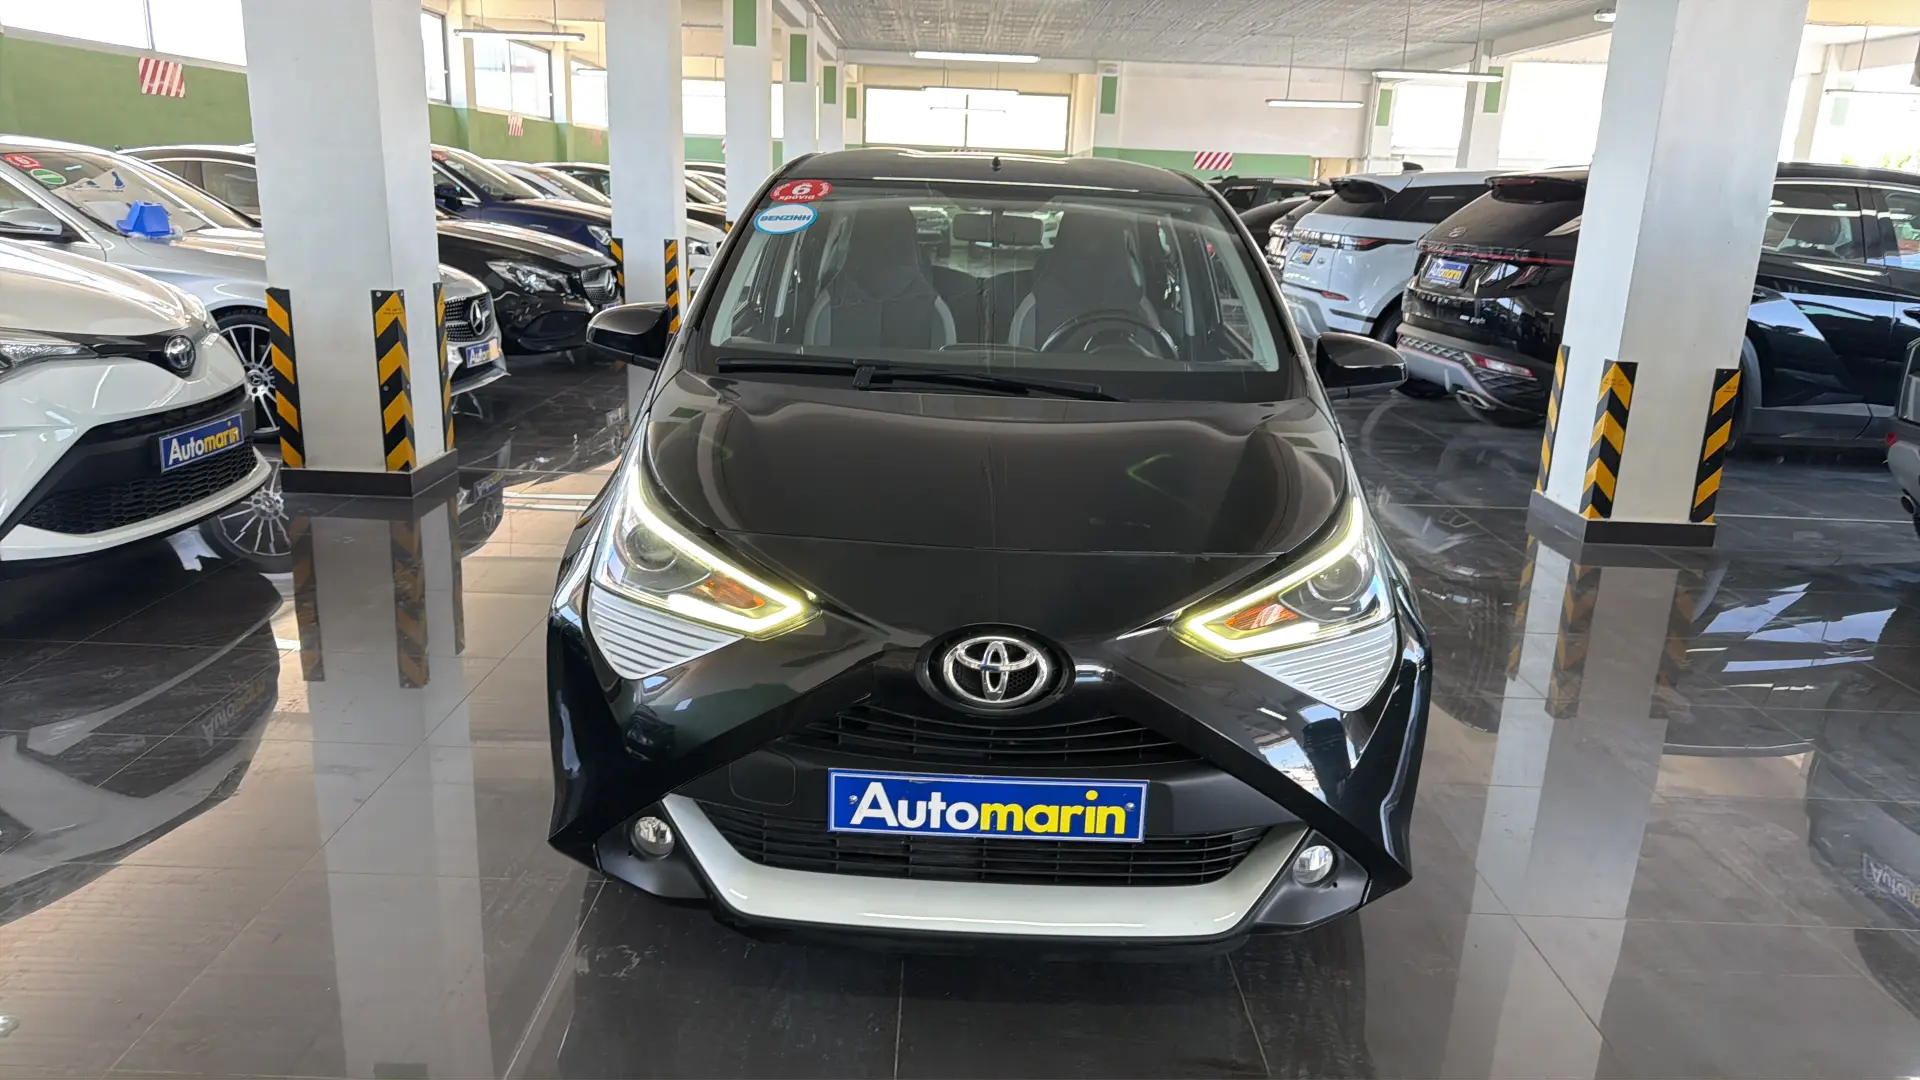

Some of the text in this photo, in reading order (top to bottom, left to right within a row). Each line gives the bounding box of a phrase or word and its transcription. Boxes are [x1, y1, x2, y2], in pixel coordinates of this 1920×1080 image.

[791, 183, 813, 195] 6
[168, 420, 240, 466] Automarin
[849, 780, 1127, 836] Automarin
